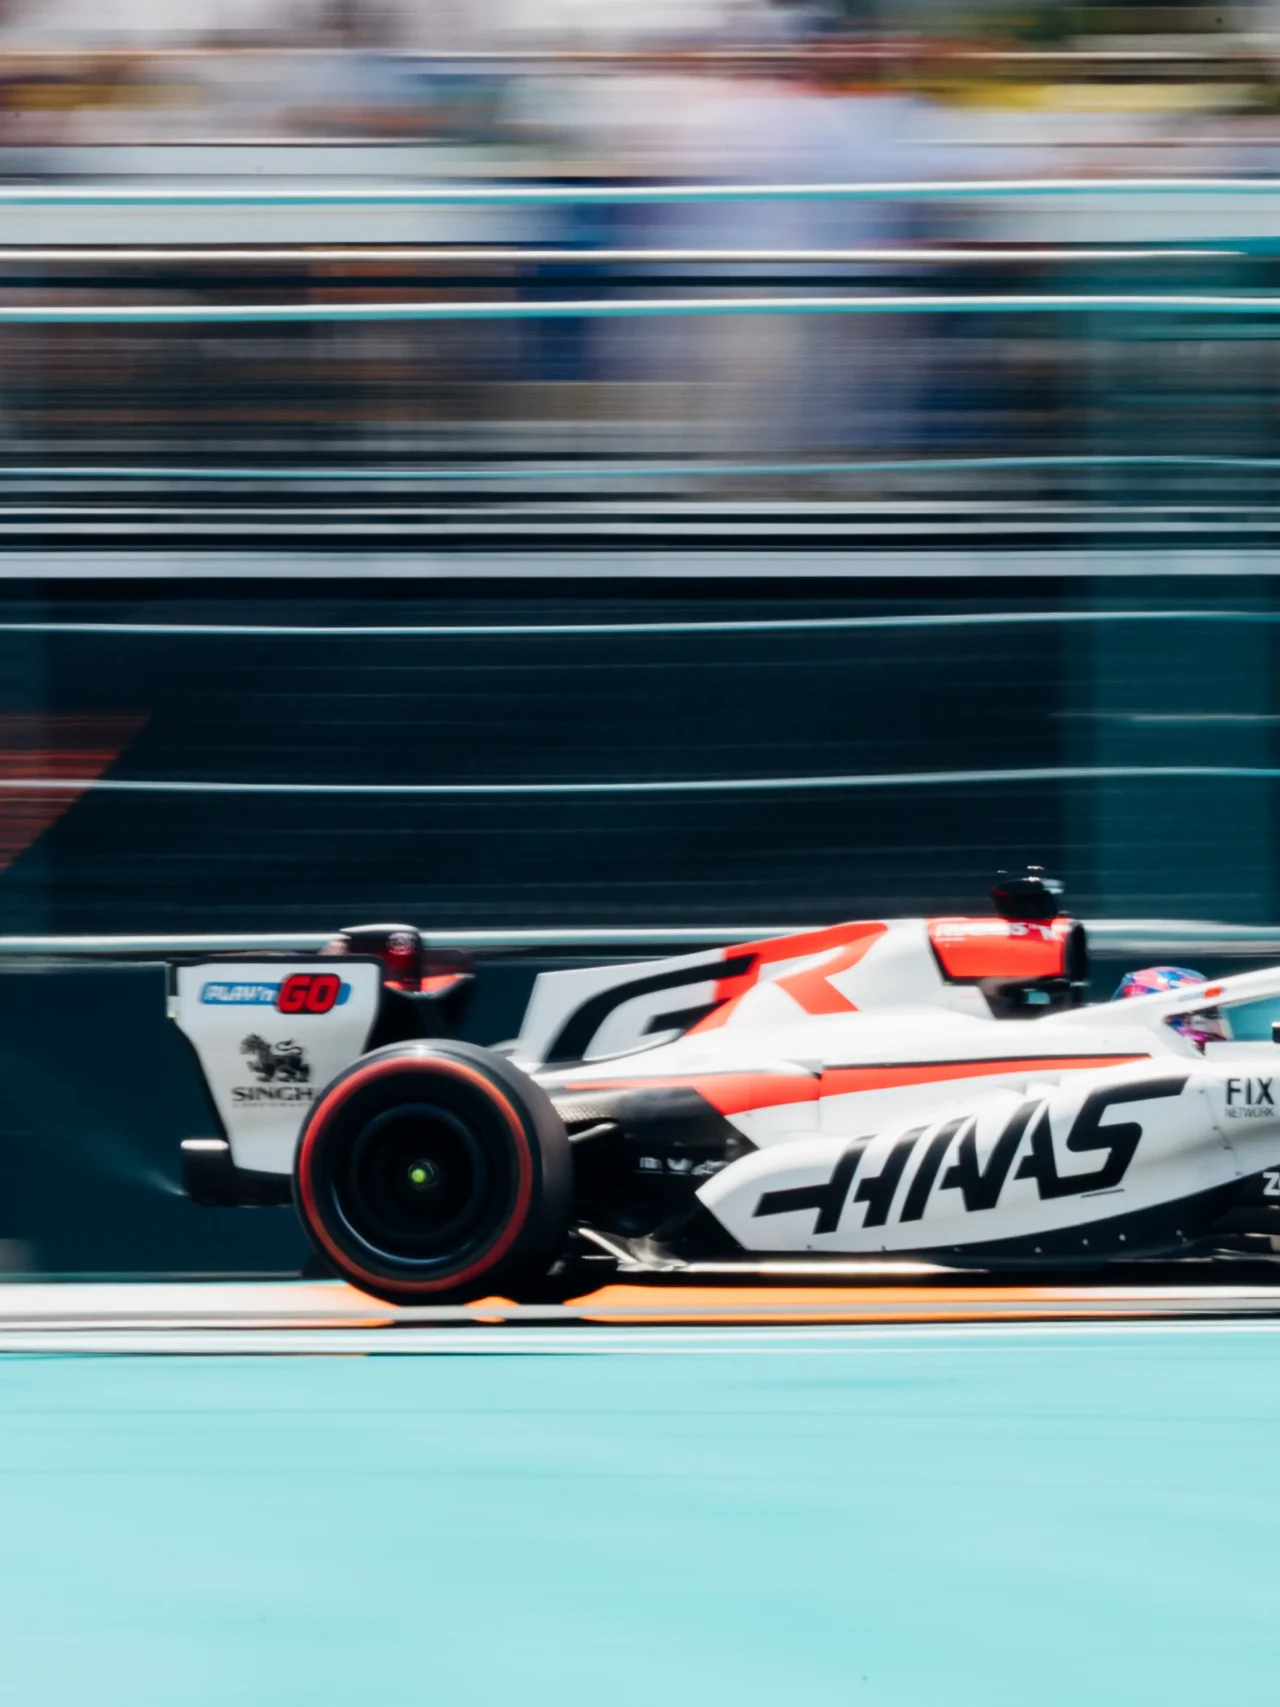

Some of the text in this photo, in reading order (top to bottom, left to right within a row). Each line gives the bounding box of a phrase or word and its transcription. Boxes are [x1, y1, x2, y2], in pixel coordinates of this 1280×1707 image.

[279, 974, 340, 1012] GO
[231, 1086, 318, 1102] SINGH
[1227, 1077, 1275, 1105] FIX
[1225, 1106, 1275, 1119] NETWORK
[752, 1075, 1190, 1235] HAAS
